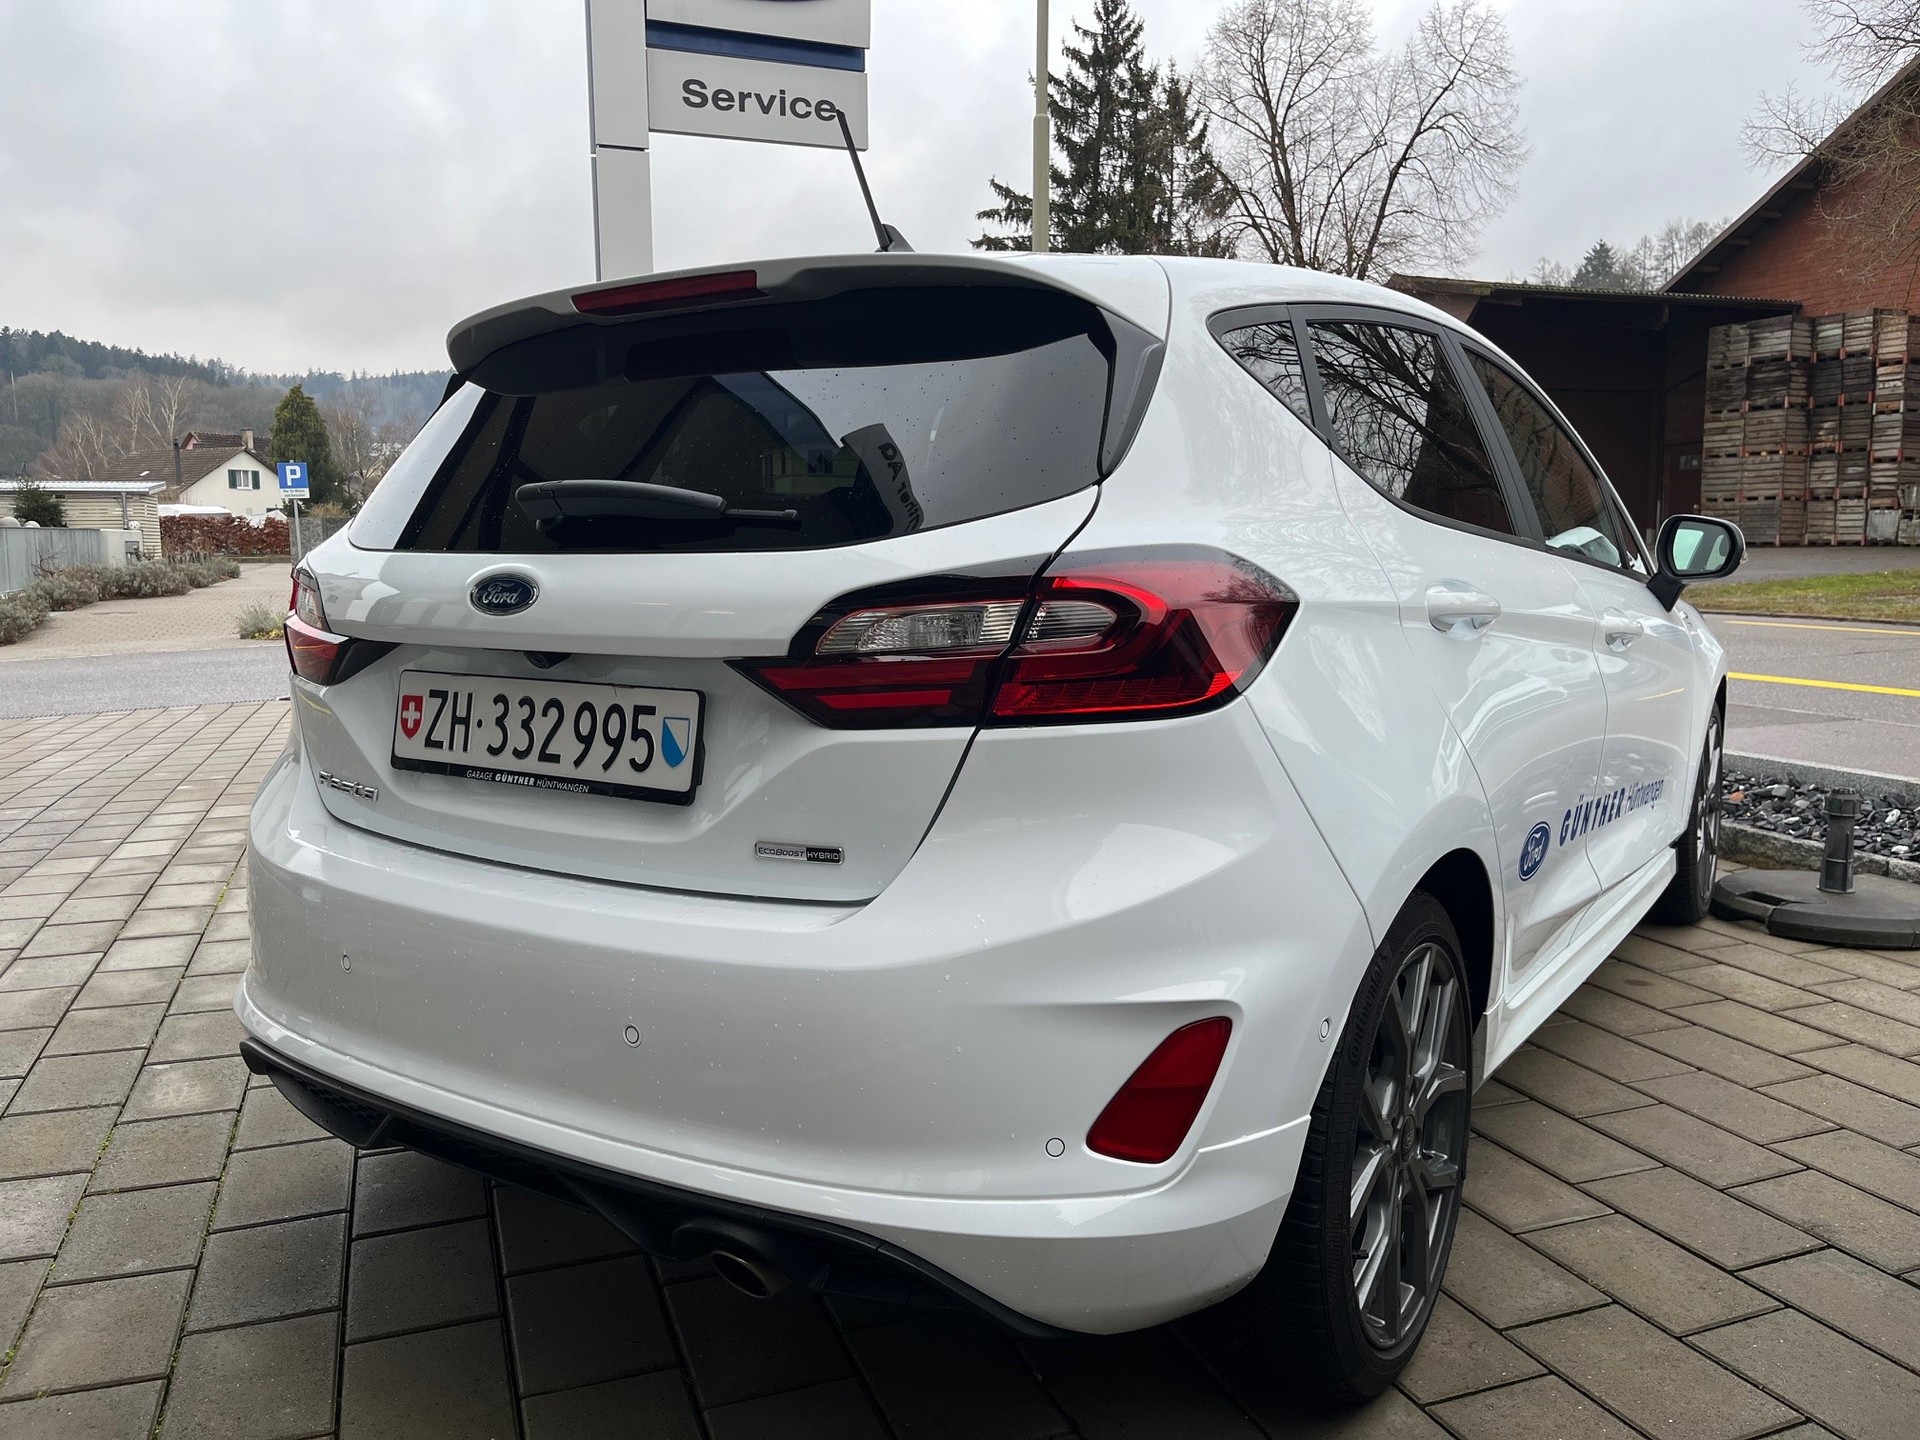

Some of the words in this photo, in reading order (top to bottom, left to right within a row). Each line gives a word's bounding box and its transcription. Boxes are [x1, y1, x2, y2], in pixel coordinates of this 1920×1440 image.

[682, 79, 837, 121] Service
[285, 465, 301, 486] P
[466, 769, 493, 781] GARAGE
[495, 772, 534, 786] GÜNTHER
[536, 778, 589, 793] HÜNTWANGEN
[1559, 787, 1626, 847] GÜNTHER
[807, 851, 839, 860] HYBRID
